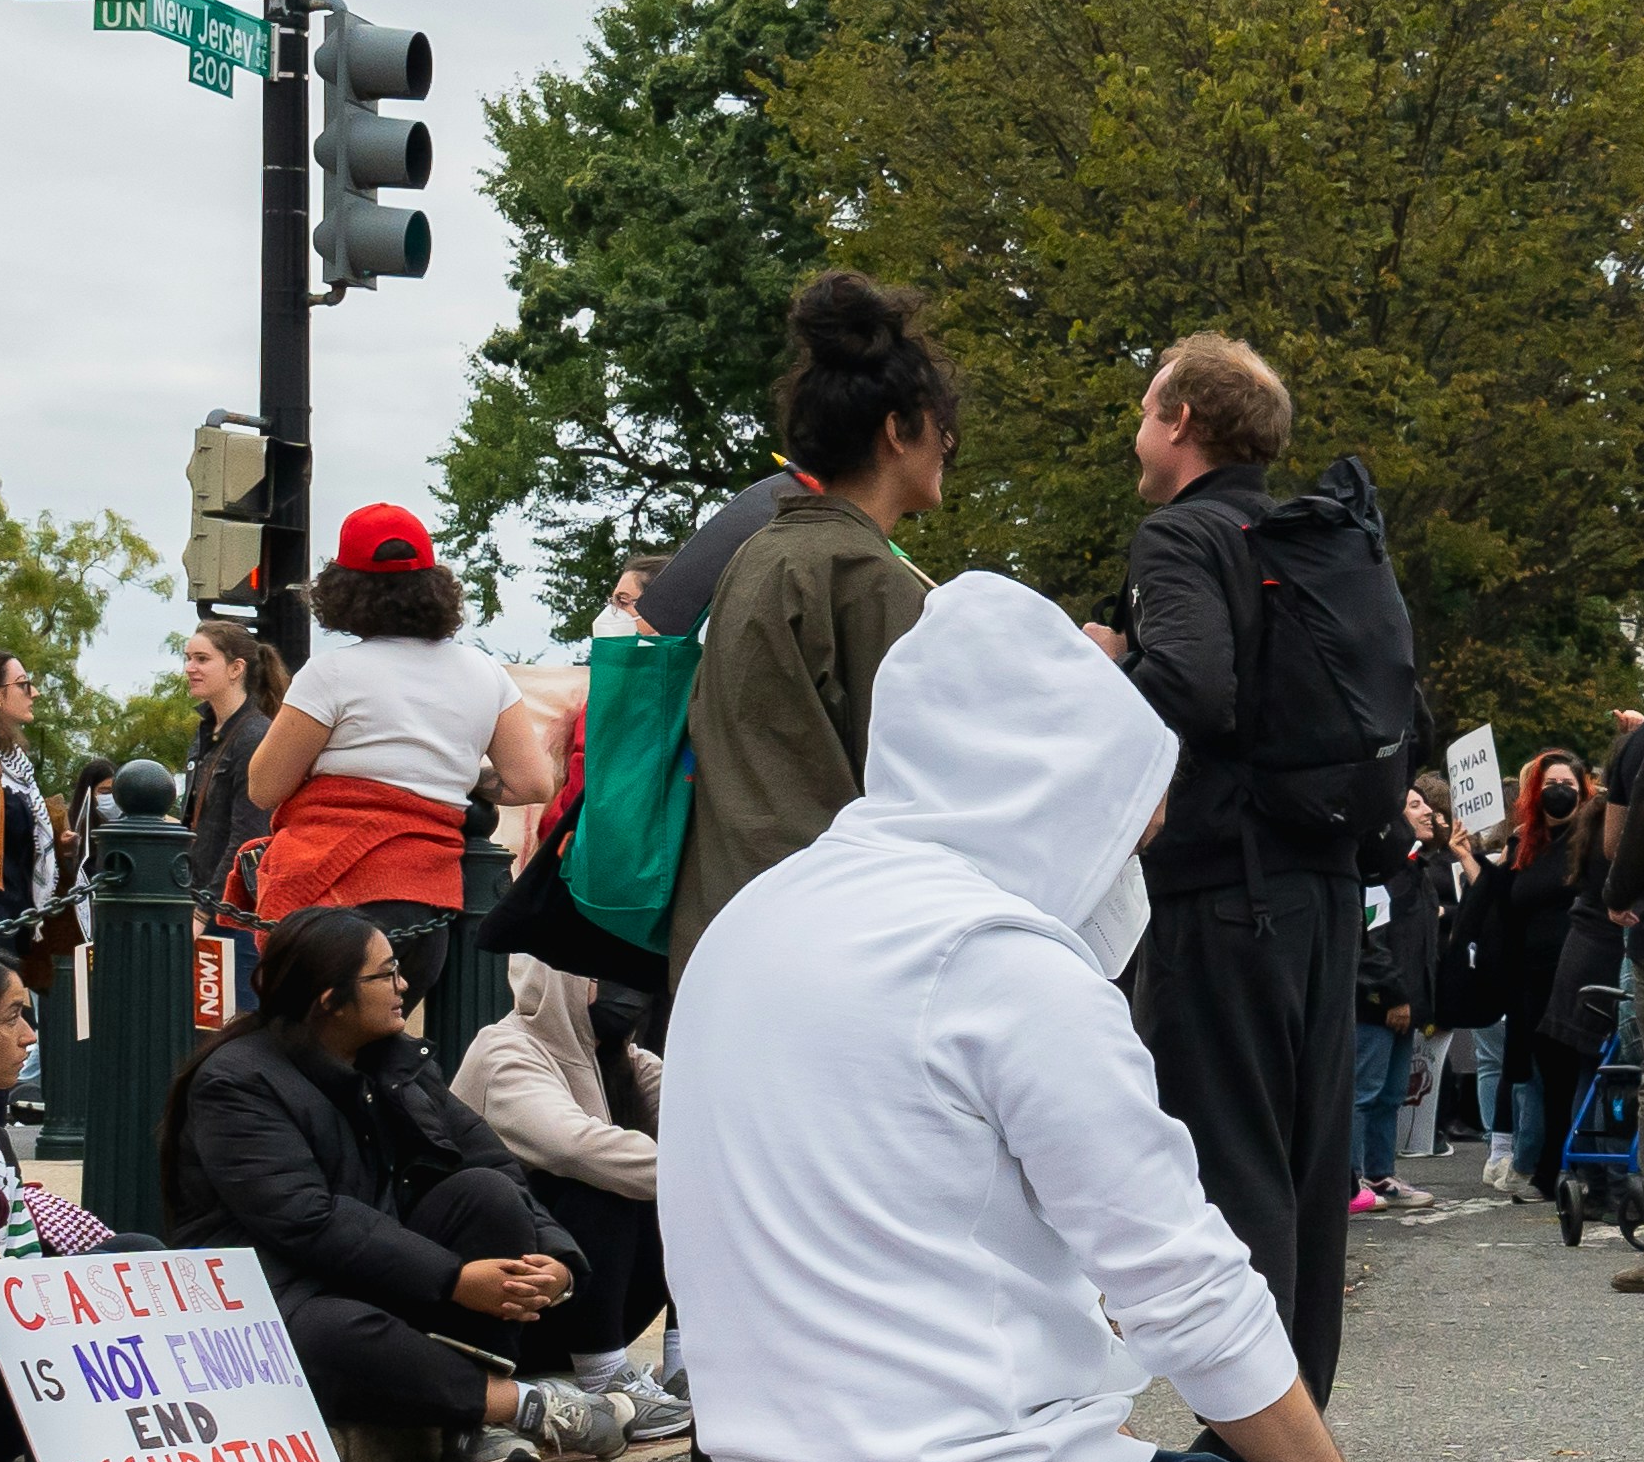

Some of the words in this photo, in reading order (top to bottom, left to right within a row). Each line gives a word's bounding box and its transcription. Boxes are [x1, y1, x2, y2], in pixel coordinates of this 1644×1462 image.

[197, 17, 255, 67] Jersey
[193, 56, 230, 90] 200
[1460, 749, 1487, 772] WAR
[1459, 777, 1474, 795] TO
[198, 951, 220, 1017] NOW!
[4, 1255, 245, 1331] CEASEFIRE
[20, 1359, 66, 1403] IS
[72, 1334, 161, 1403] NOT
[165, 1321, 304, 1395] ENOUGH!
[125, 1401, 218, 1450] END
